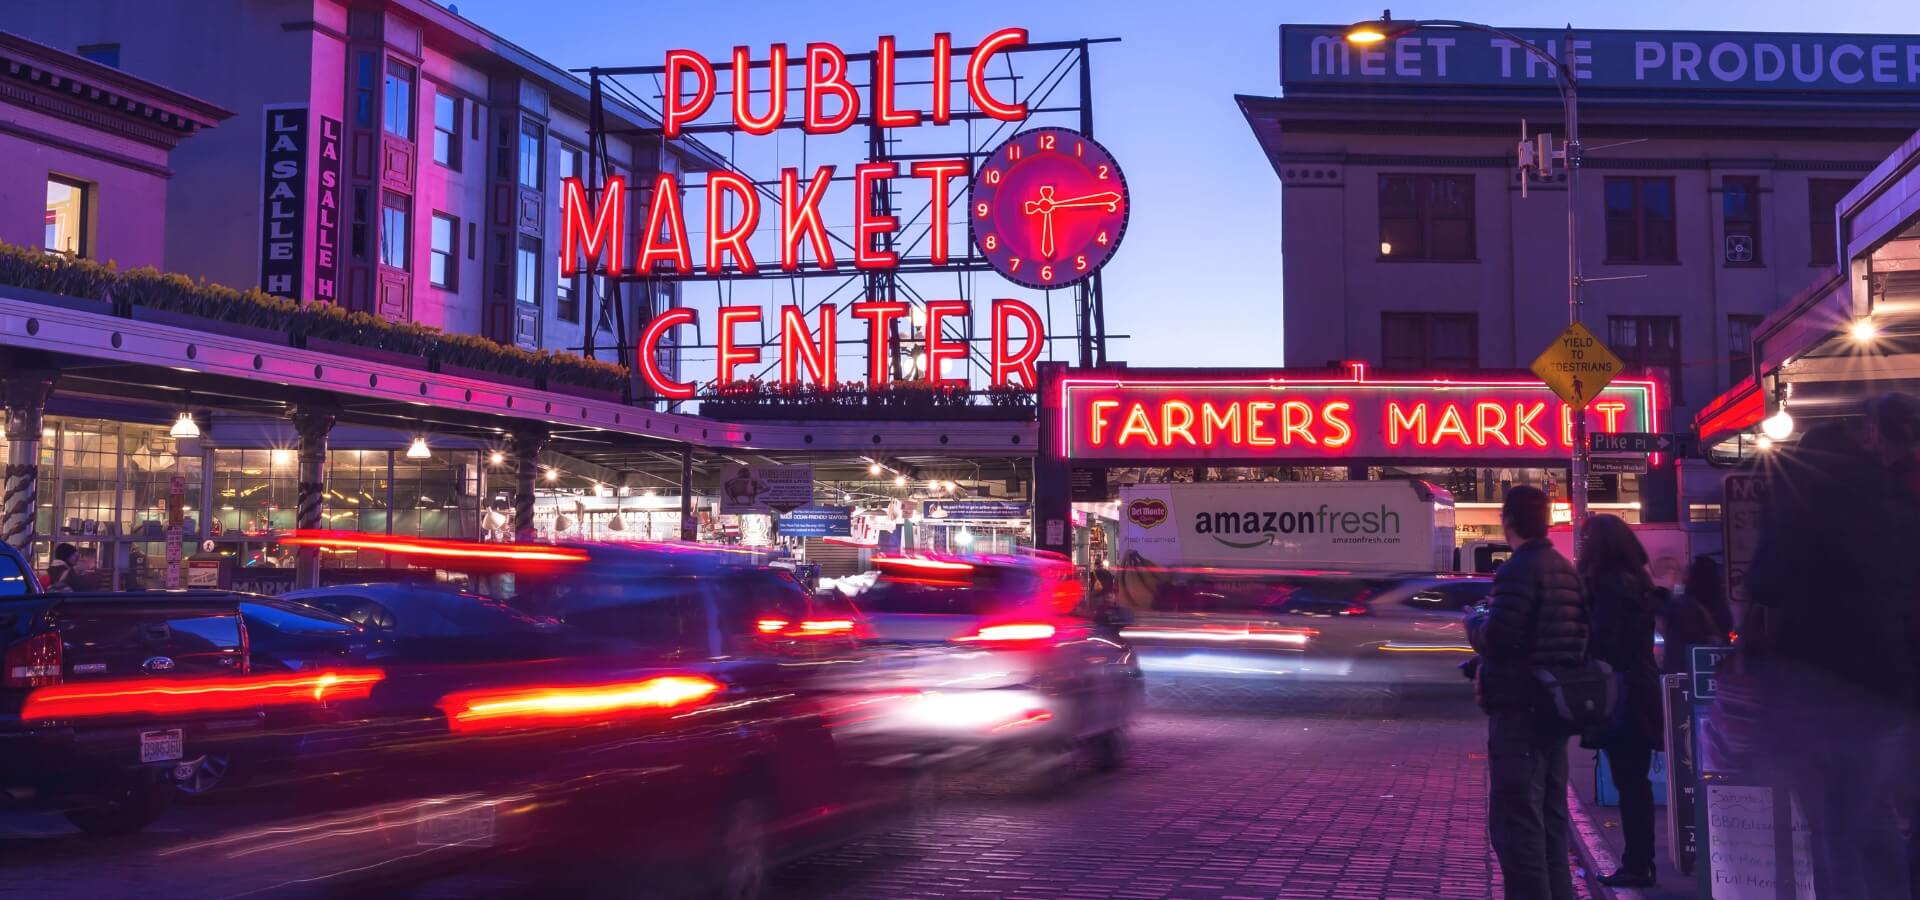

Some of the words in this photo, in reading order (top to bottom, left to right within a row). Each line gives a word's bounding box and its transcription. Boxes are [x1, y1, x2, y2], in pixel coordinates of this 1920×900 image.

[1311, 35, 1456, 77] MEET
[1491, 39, 1592, 80] THE
[663, 27, 1029, 140] PUBLIC
[271, 114, 298, 152] LA
[322, 120, 337, 161] LA
[1040, 136, 1054, 149] 12
[1009, 146, 1021, 160] 11
[986, 170, 1000, 184] 10
[1098, 165, 1109, 179] 2
[269, 160, 298, 260] SALLE
[977, 203, 988, 217] 9
[318, 170, 336, 268] SALLE
[561, 159, 970, 278] MARKET
[986, 236, 996, 249] 8
[1097, 232, 1108, 245] 4
[1010, 258, 1021, 272] 7
[1077, 256, 1087, 270] 5
[1041, 266, 1052, 281] 6
[638, 299, 1045, 399] CENTER
[1562, 337, 1593, 348] YIELD
[1571, 350, 1584, 360] TO
[1551, 362, 1612, 372] DESTRIANS
[1092, 400, 1350, 446] FARMERS
[1388, 402, 1626, 446] MARKET
[1594, 434, 1628, 449] Pike
[1195, 504, 1400, 534] amazonfresh
